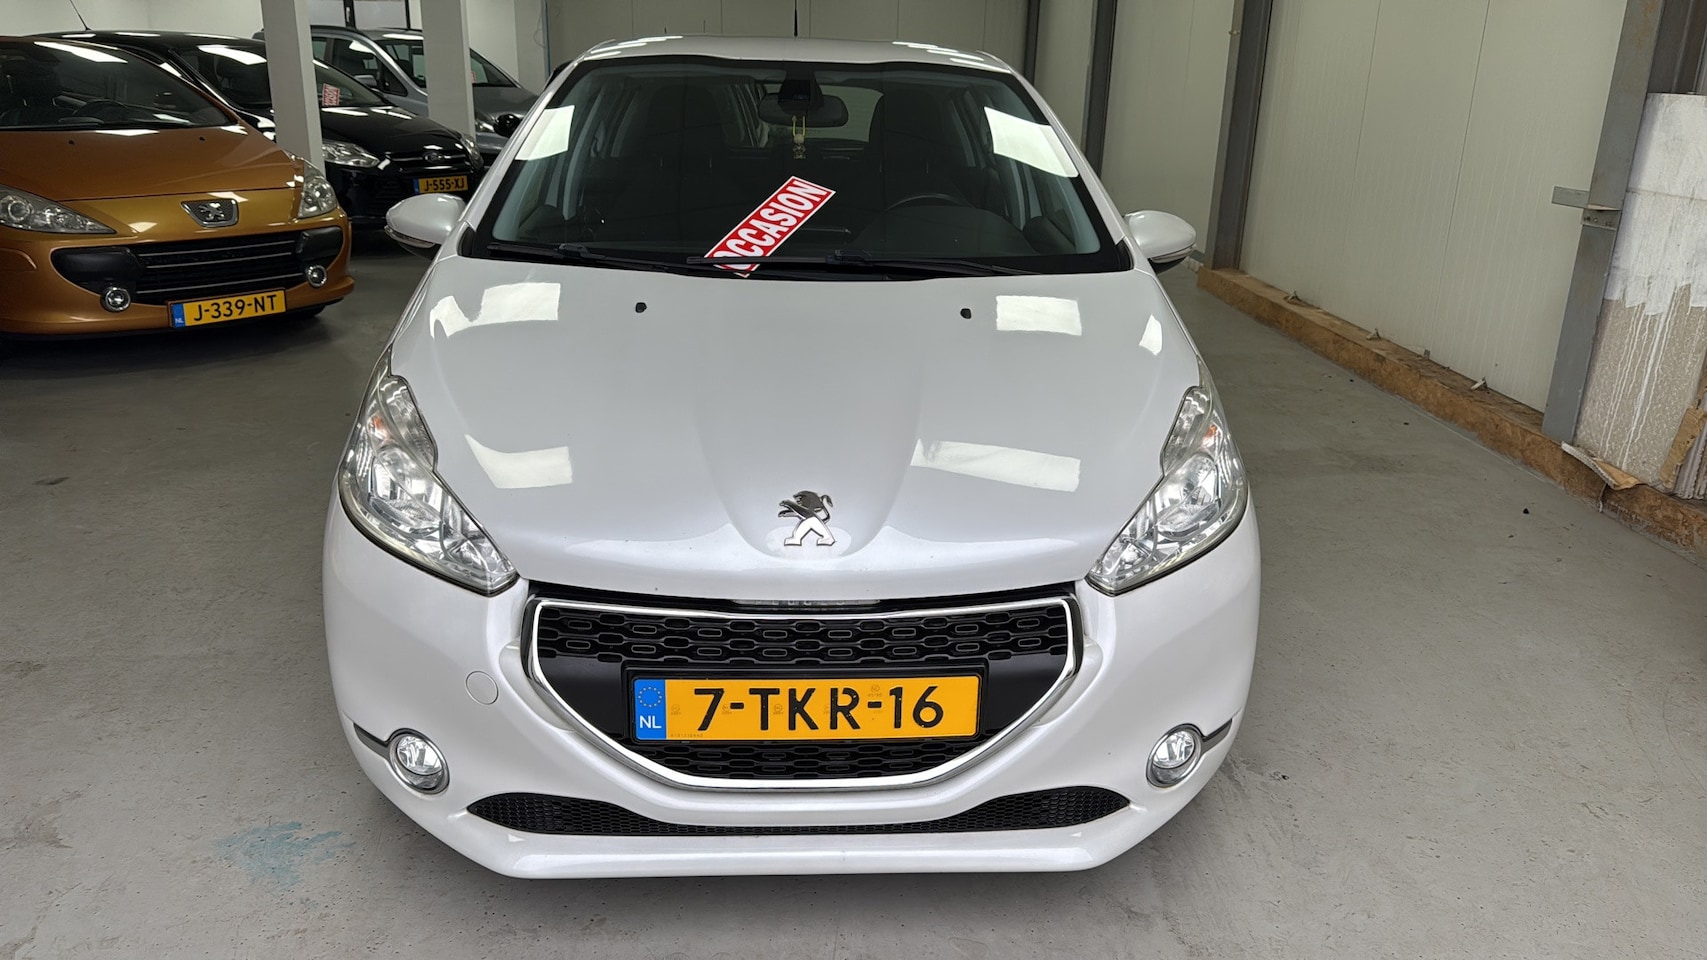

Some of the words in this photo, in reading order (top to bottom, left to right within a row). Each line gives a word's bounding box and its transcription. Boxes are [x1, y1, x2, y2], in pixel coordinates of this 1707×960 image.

[424, 178, 464, 191] J-555-XJ
[193, 294, 277, 321] J-339-NT
[694, 685, 944, 730] 7-TKR-16
[639, 714, 661, 729] NL
